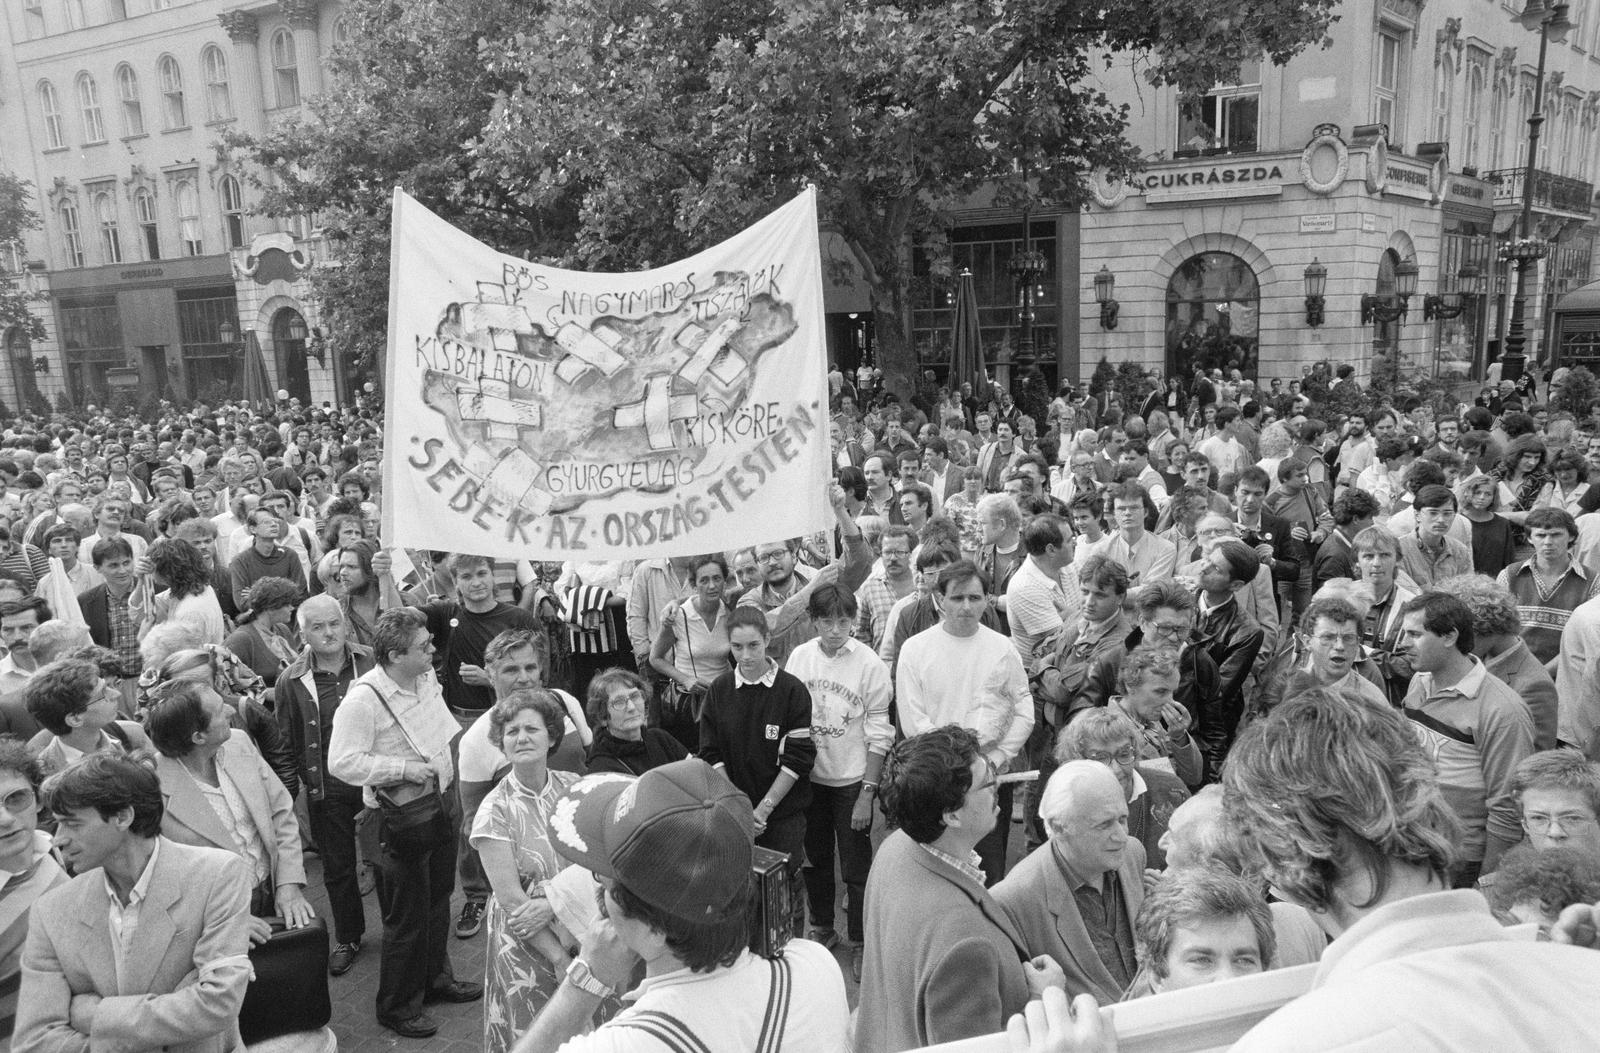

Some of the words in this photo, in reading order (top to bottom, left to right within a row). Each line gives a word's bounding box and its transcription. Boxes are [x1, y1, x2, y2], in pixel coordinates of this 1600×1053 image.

[1145, 166, 1283, 188] CUKRÁSZDA
[561, 272, 695, 316] NAGYMAROS
[415, 334, 548, 393] KISBALATON
[683, 401, 780, 449] KISKÖRE
[545, 515, 588, 550] AZ
